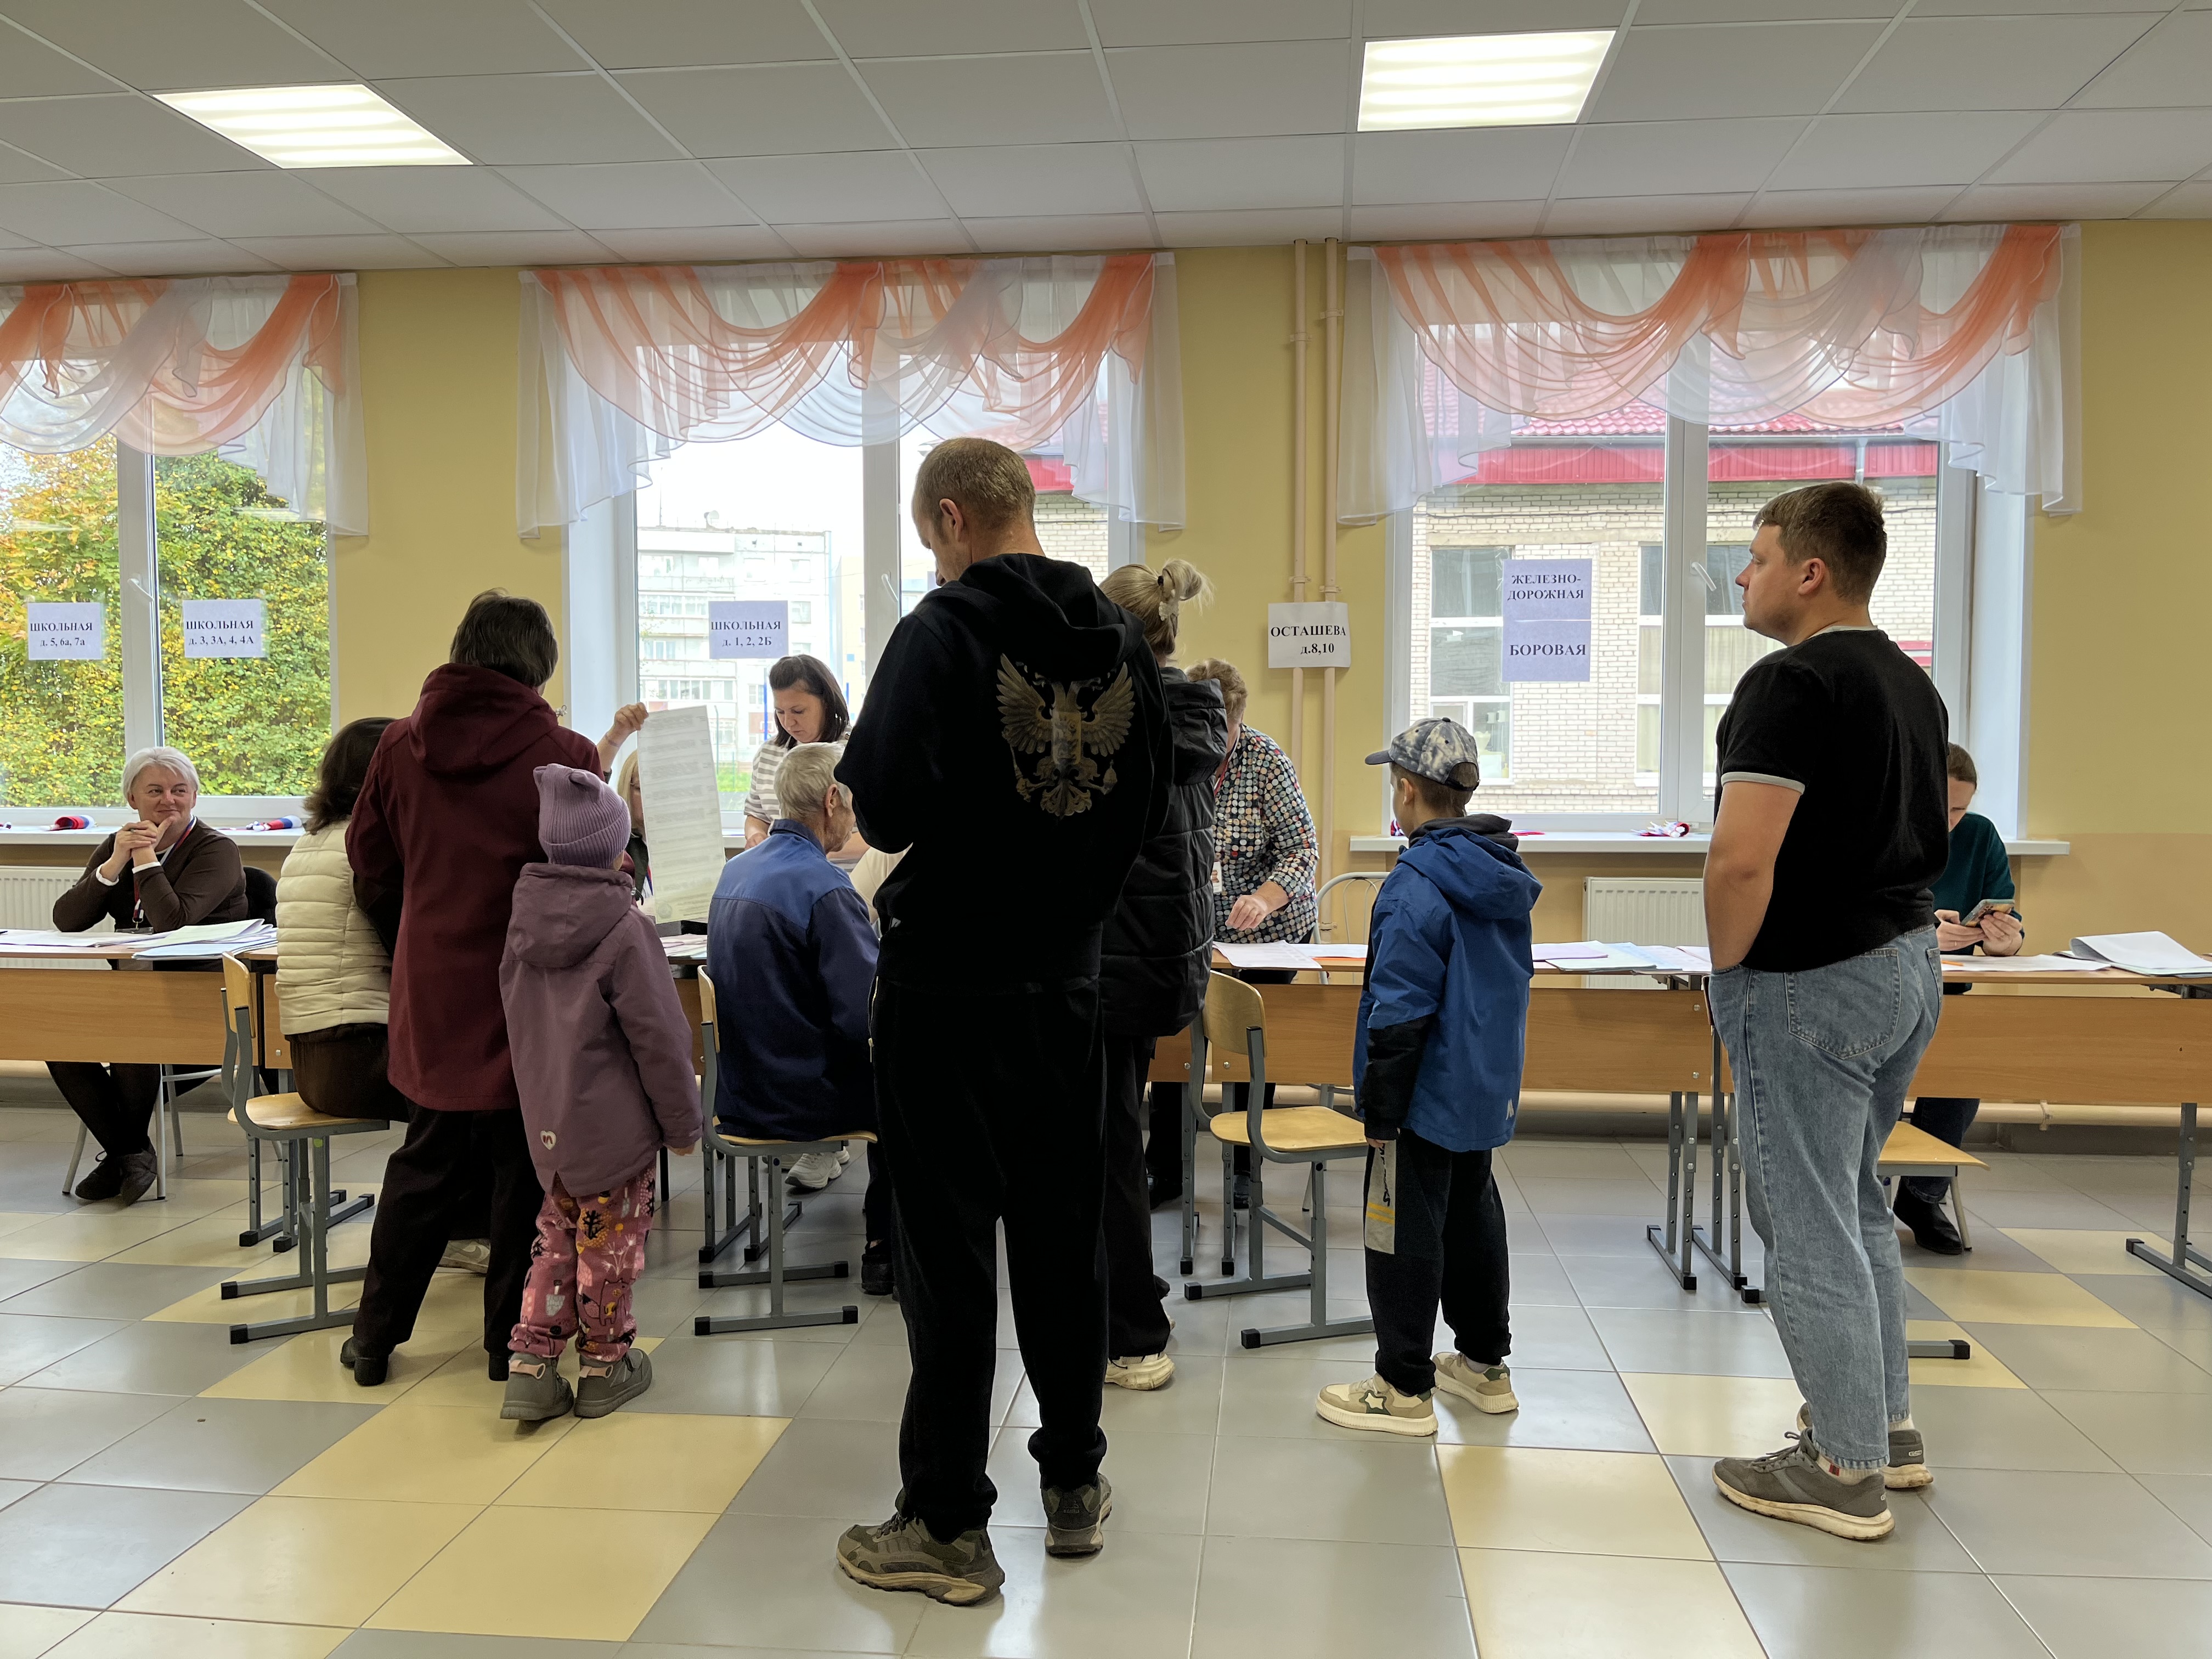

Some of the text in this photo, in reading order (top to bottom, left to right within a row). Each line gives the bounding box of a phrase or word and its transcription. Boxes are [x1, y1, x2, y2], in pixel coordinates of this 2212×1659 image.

[1511, 574, 1581, 584] ЖЕЛЕЗНО-
[1508, 589, 1584, 601] ДОРОЖНАЯ
[30, 622, 92, 631] ШКОЛЬНАЯ
[186, 620, 253, 630] ШКОЛЬНАЯ
[711, 621, 781, 630] ШКОЛЬНАЯ
[1271, 625, 1346, 637] ОСТАШЕВА
[50, 637, 58, 647] 5,
[60, 637, 72, 647] 6а,
[75, 637, 85, 646] 7а
[200, 636, 208, 646] 3,
[211, 636, 227, 646] 3А,
[229, 635, 237, 645] 4,
[240, 635, 254, 644] 4А
[735, 637, 743, 647] 1,
[746, 637, 755, 647] 2,
[758, 636, 772, 646] 2Б
[1300, 643, 1334, 655] д.8,10
[1510, 644, 1586, 656] БОРОВАЯ
